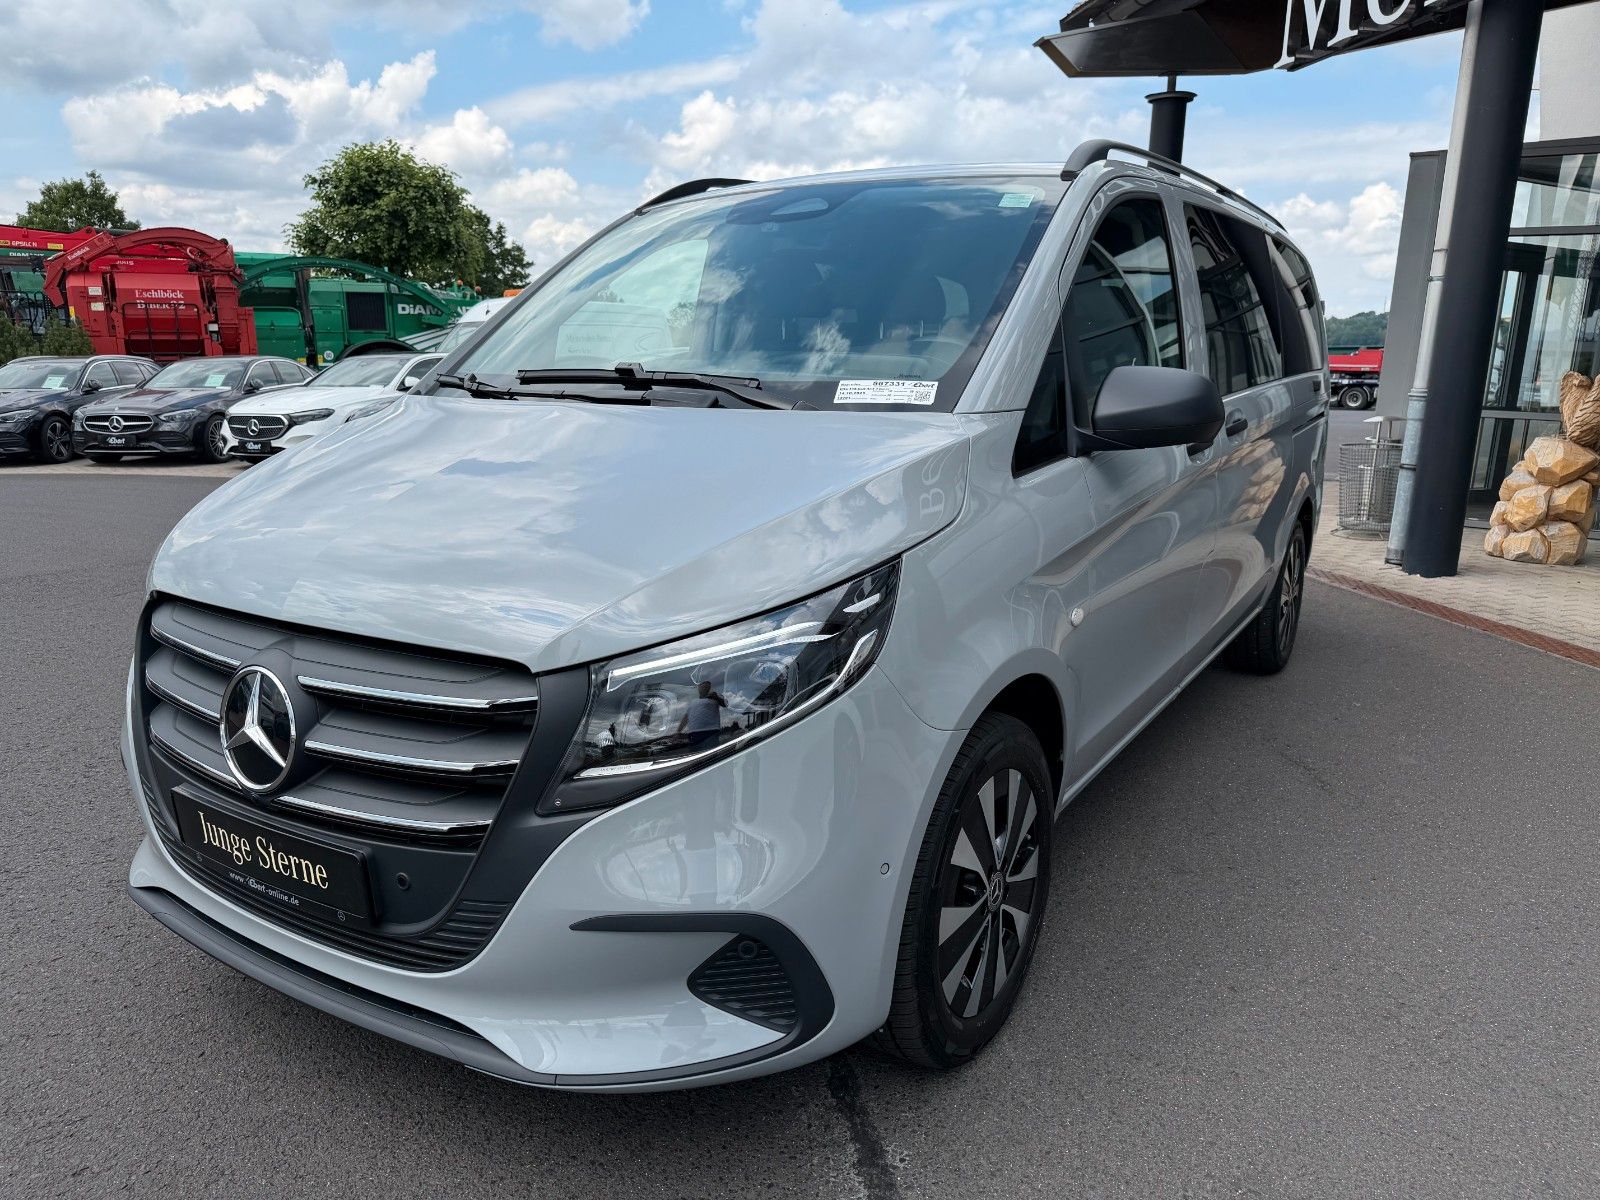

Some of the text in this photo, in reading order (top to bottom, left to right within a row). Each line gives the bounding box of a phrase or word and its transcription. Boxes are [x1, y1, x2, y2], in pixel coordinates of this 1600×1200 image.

[135, 289, 185, 299] Eschlböck
[198, 811, 329, 889] Junge Sterne
